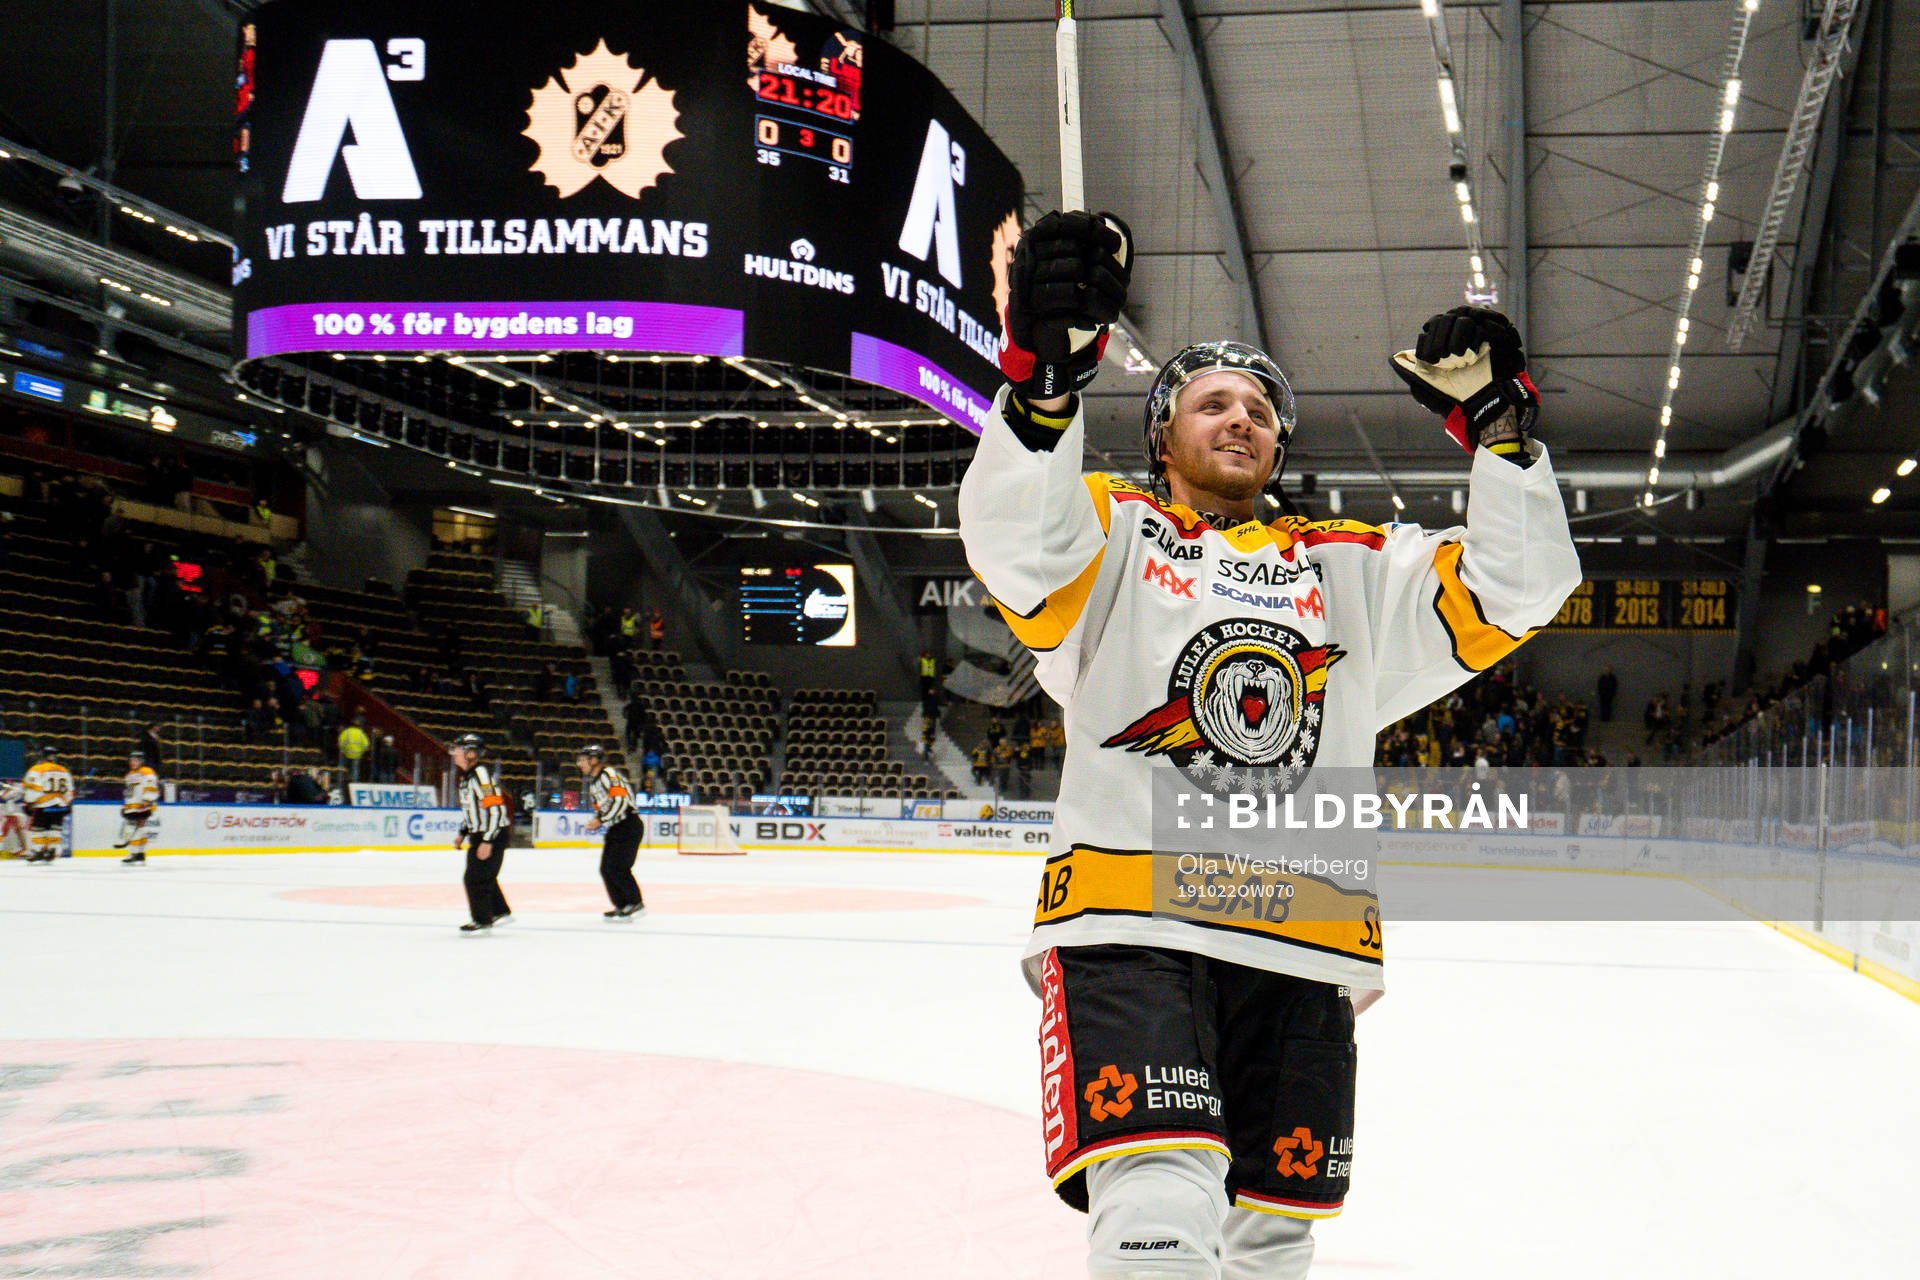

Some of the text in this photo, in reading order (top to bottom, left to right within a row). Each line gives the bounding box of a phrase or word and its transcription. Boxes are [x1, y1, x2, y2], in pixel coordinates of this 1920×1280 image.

[778, 63, 813, 80] LOCAL
[758, 73, 852, 119] 21:20
[758, 120, 851, 164] 0 3 0
[757, 149, 781, 166] 35
[828, 166, 850, 184] 31
[265, 212, 708, 260] VI STÅR TILLSAMMANS
[744, 254, 855, 294] HULTDINS
[881, 262, 910, 303] VI
[916, 280, 955, 333] STÅR
[313, 311, 634, 339] 100 % för bygdens lag
[918, 366, 940, 395] 100
[1044, 364, 1055, 395] KOVACS
[1157, 527, 1204, 560] LKAB
[1237, 526, 1259, 538] SHL
[1142, 556, 1195, 598] MAX
[1217, 559, 1288, 586] SSAB
[920, 581, 975, 607] AIK
[1211, 582, 1294, 610] SCANIA
[1294, 586, 1327, 621] MA
[1615, 598, 1659, 625] 2013
[1681, 598, 1726, 625] 2014
[1176, 622, 1300, 689] LULEÅ HOCKEY
[998, 806, 1055, 821] Specm
[757, 823, 826, 840] BDX
[954, 825, 1012, 839] valutec
[1479, 845, 1558, 857] Handelsbanken
[1169, 866, 1295, 924] SSAB
[1145, 1065, 1210, 1090] Luleå
[1329, 1136, 1353, 1155] Lule
[1120, 1240, 1180, 1251] BAUER
